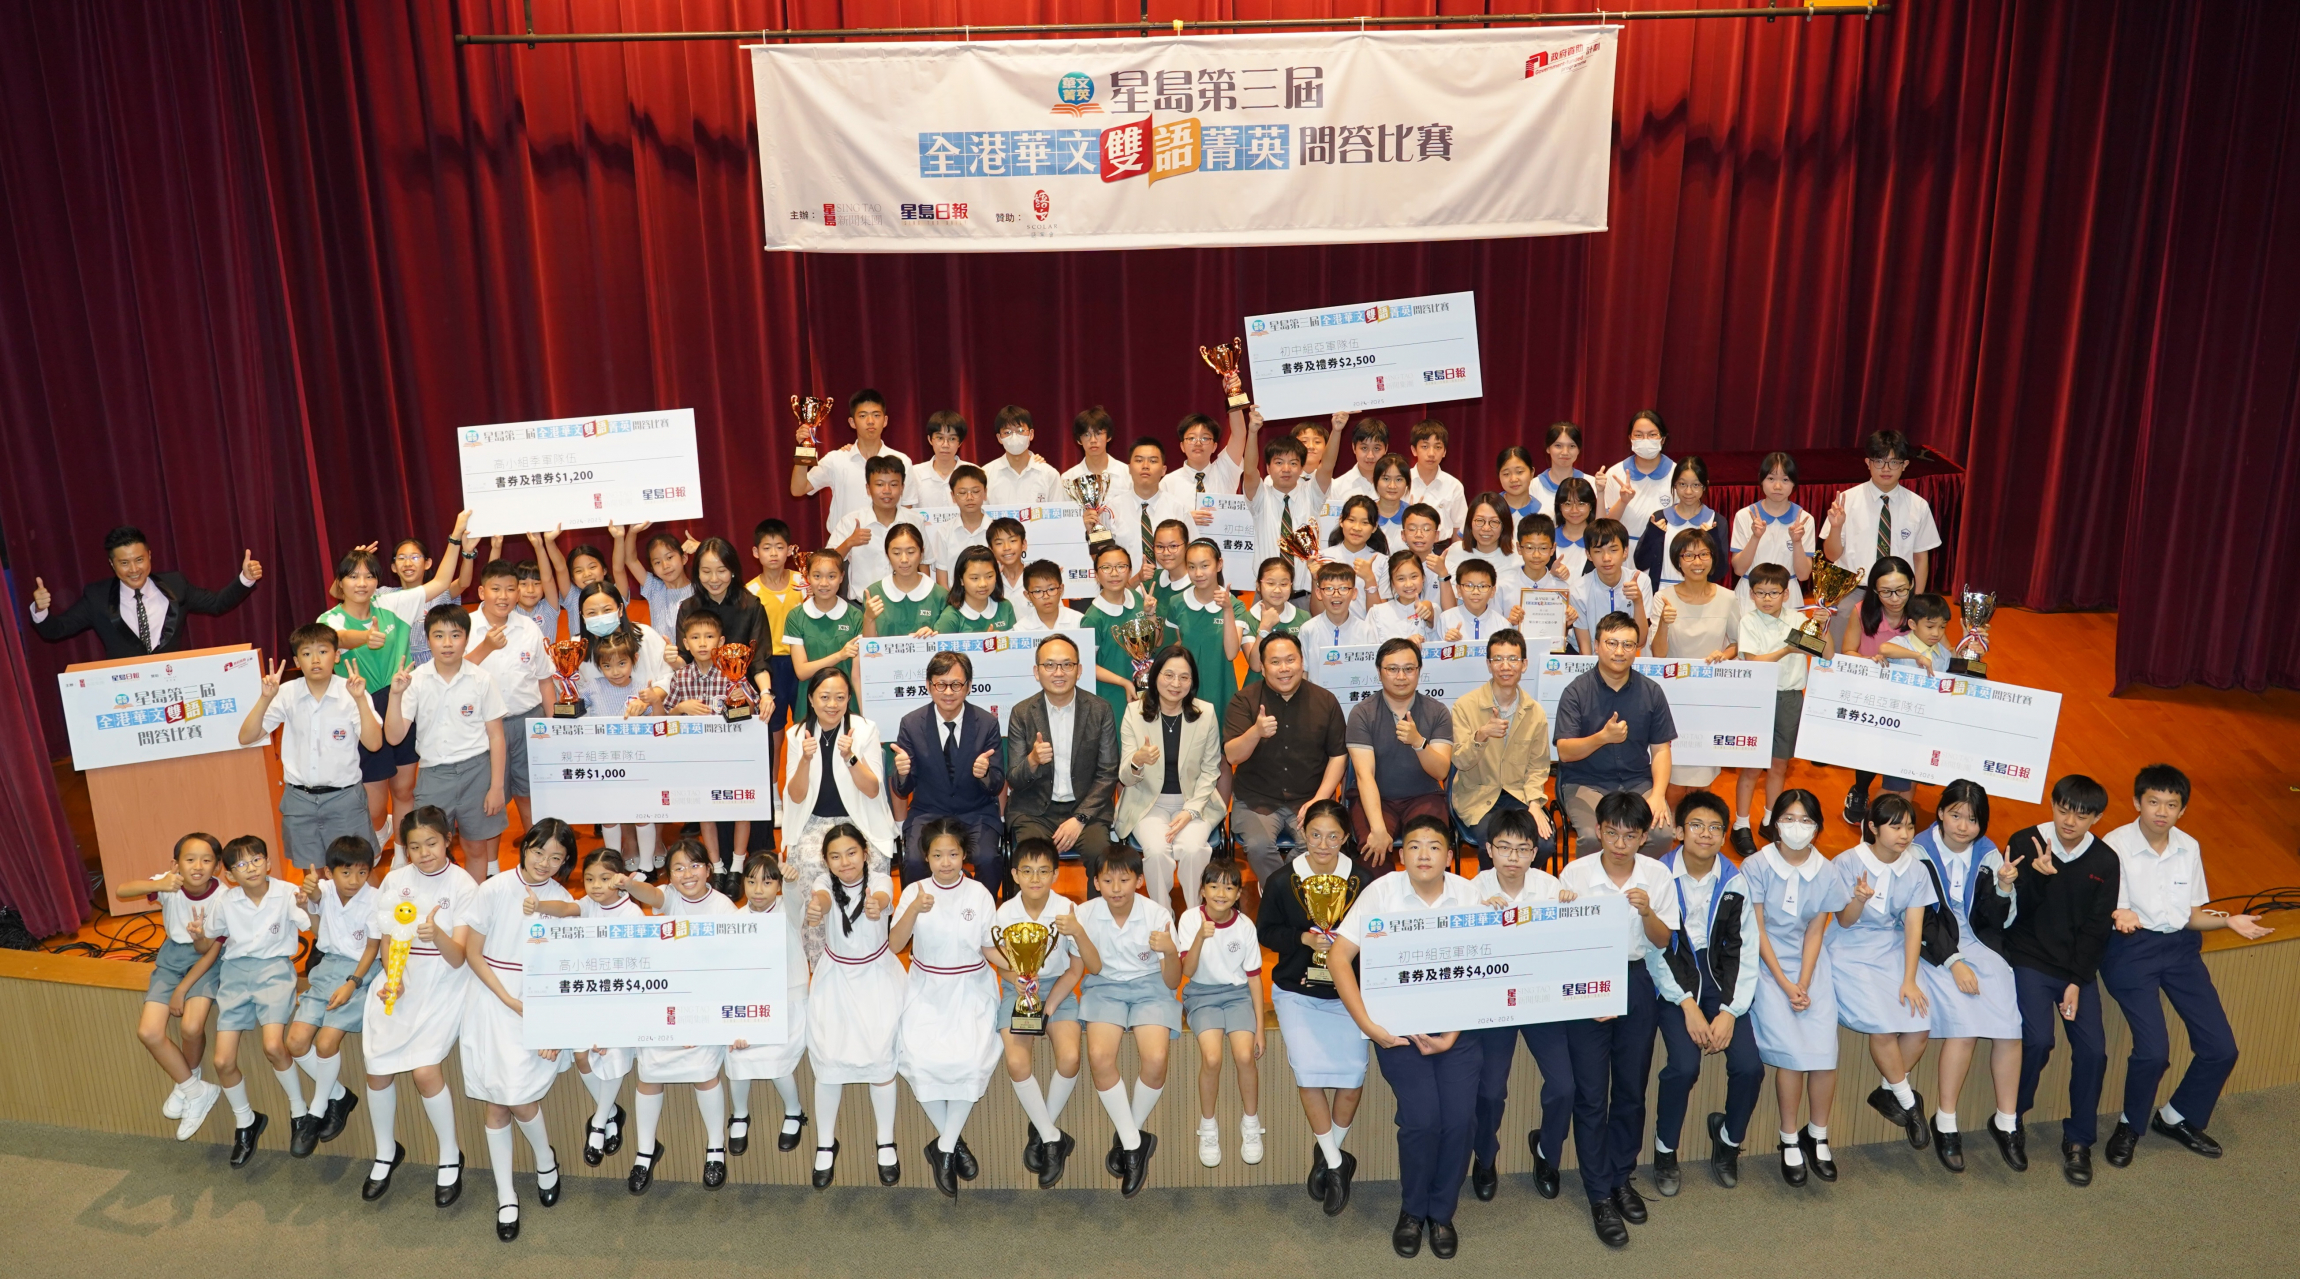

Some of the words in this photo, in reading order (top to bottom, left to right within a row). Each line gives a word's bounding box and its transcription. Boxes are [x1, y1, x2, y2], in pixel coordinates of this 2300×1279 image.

[1062, 76, 1090, 89] 華文
[1110, 66, 1323, 114] 星島第三屆
[1063, 89, 1090, 101] 菁英
[836, 203, 861, 213] SING
[861, 203, 881, 213] TAO
[900, 202, 969, 220] 星島日報
[837, 214, 883, 226] 新聞集團
[1281, 354, 1377, 375] 書券及禮券$2,500
[1423, 367, 1466, 382] 星島日報
[495, 470, 594, 488] 書券及禮券$1,200
[642, 486, 687, 501] 星島日報
[1222, 539, 1254, 551] 書券及
[920, 609, 932, 617] KTS
[994, 620, 1007, 628] KTS
[134, 683, 216, 707] 星島第三屆
[98, 700, 237, 730] 全港華文雙語菁英
[1836, 706, 1901, 728] 書券$2,000
[138, 724, 203, 747] 問答比賽
[1713, 734, 1758, 747] 星島日報
[562, 768, 626, 780] 書券$1,000
[1982, 759, 2031, 779] 星島日報
[711, 789, 756, 801] 星島日報
[1397, 963, 1510, 984] 書券及禮券$4,000
[558, 978, 669, 994] 書券及禮券$4,000
[1562, 980, 1611, 996] 星島日報
[721, 1004, 771, 1018] 星島日報
